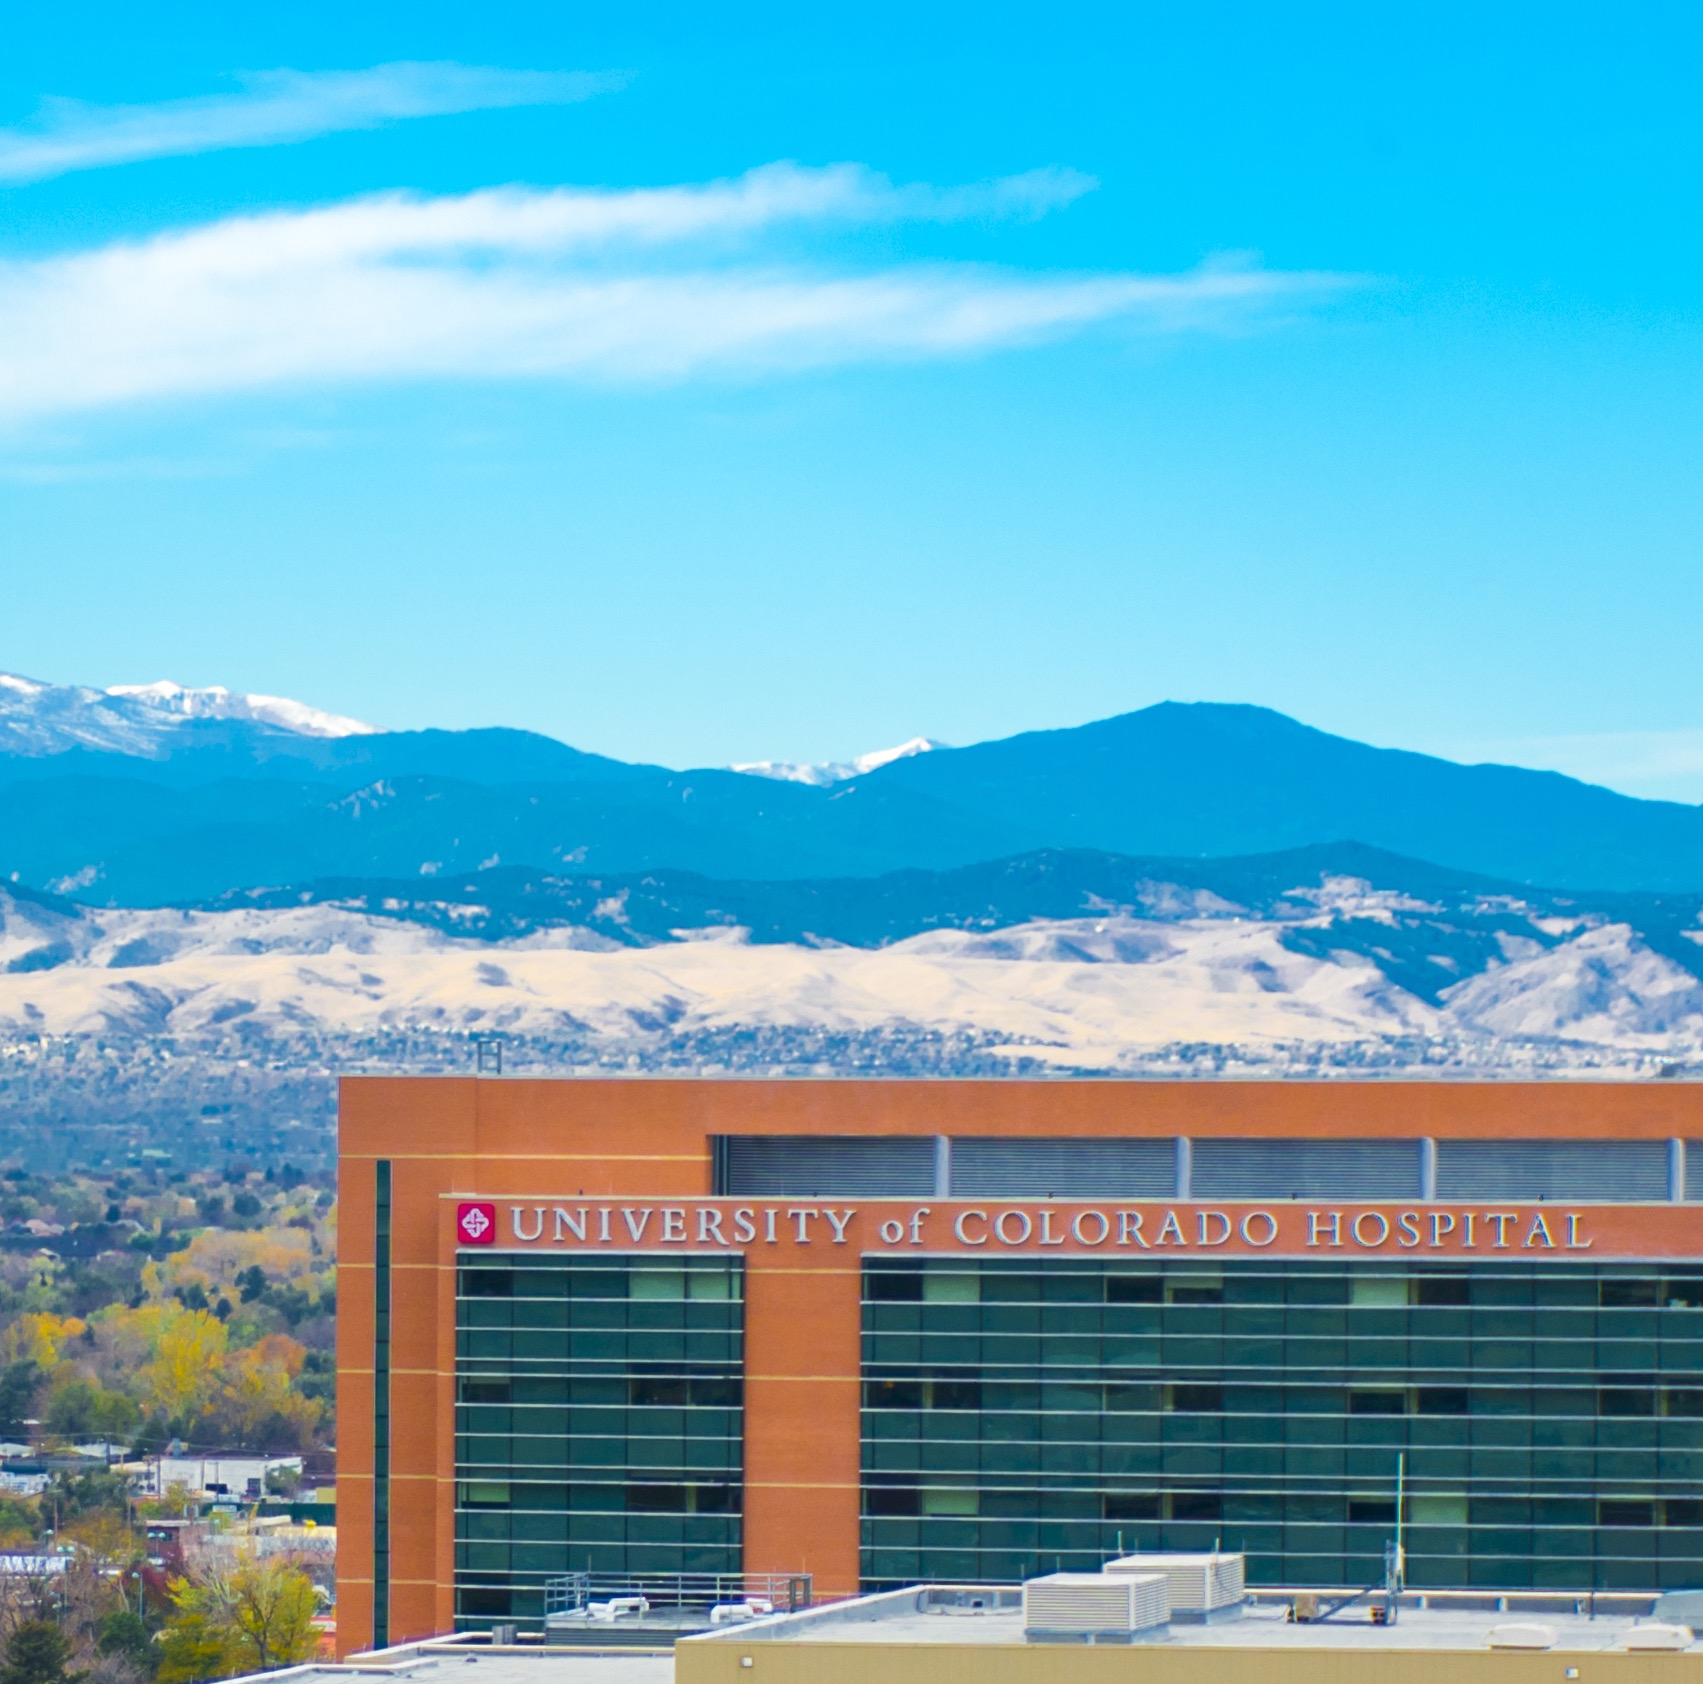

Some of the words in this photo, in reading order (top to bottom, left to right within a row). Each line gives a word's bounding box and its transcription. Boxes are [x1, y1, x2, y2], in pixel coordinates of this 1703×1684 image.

[510, 1206, 859, 1245] UNIVERSITY
[879, 1208, 929, 1245] of
[953, 1209, 1279, 1248] COLORADO
[1305, 1211, 1594, 1250] HOSPITAL
